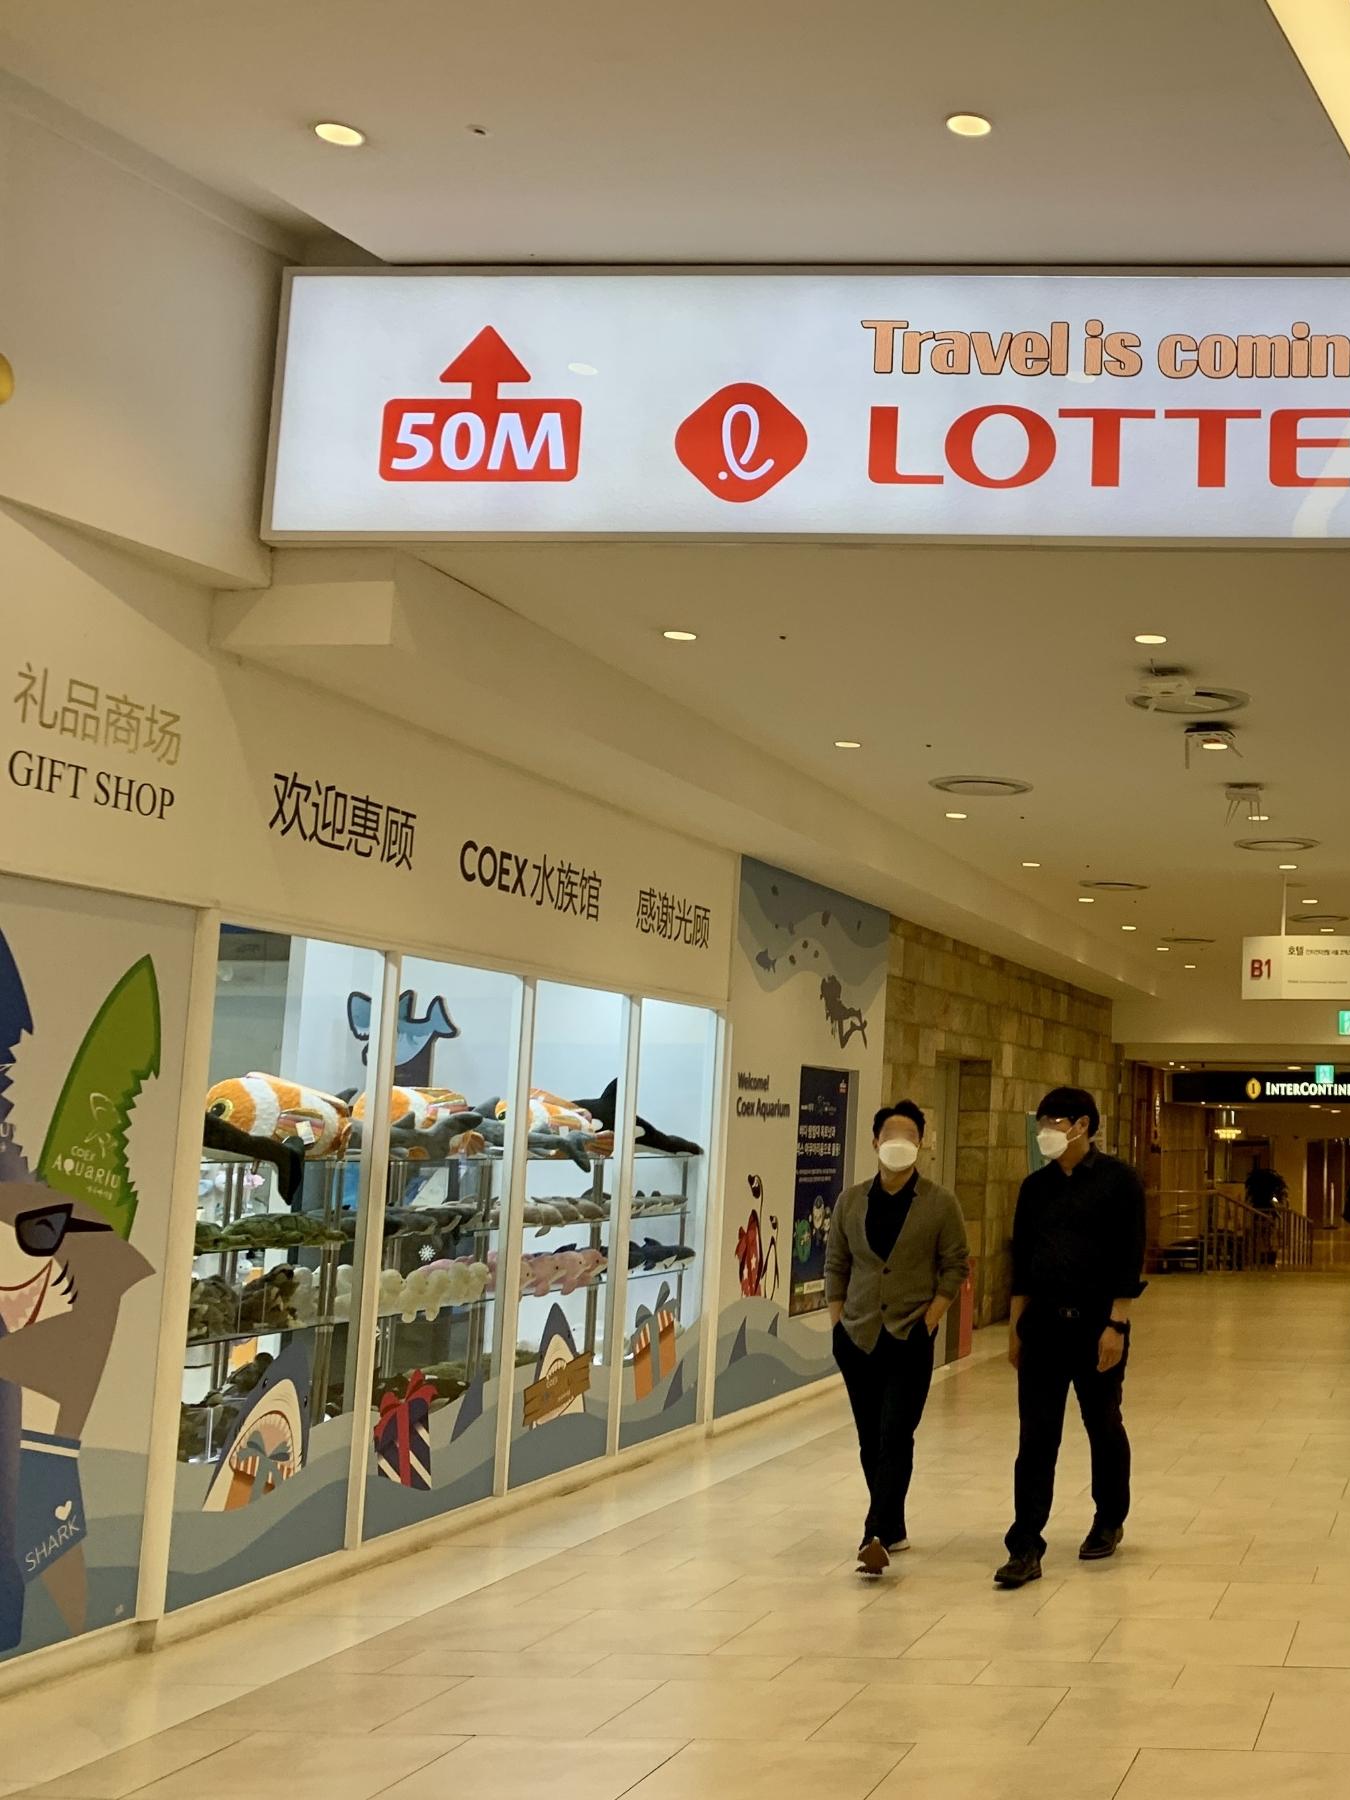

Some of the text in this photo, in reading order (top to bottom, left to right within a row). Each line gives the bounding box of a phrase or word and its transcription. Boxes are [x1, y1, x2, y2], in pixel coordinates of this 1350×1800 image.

[861, 319, 1070, 376] Travel
[1084, 318, 1143, 378] is
[391, 410, 567, 472] 50M
[13, 661, 182, 767] 礼品商场
[8, 749, 176, 820] GIFT SHOP
[268, 771, 418, 871] 欢迎惠顾
[635, 886, 712, 950] 感谢光顾
[1249, 958, 1273, 980] B1
[736, 1096, 755, 1118] Coex
[756, 1097, 791, 1123] Aquarium
[25, 1515, 81, 1572] SHARK
